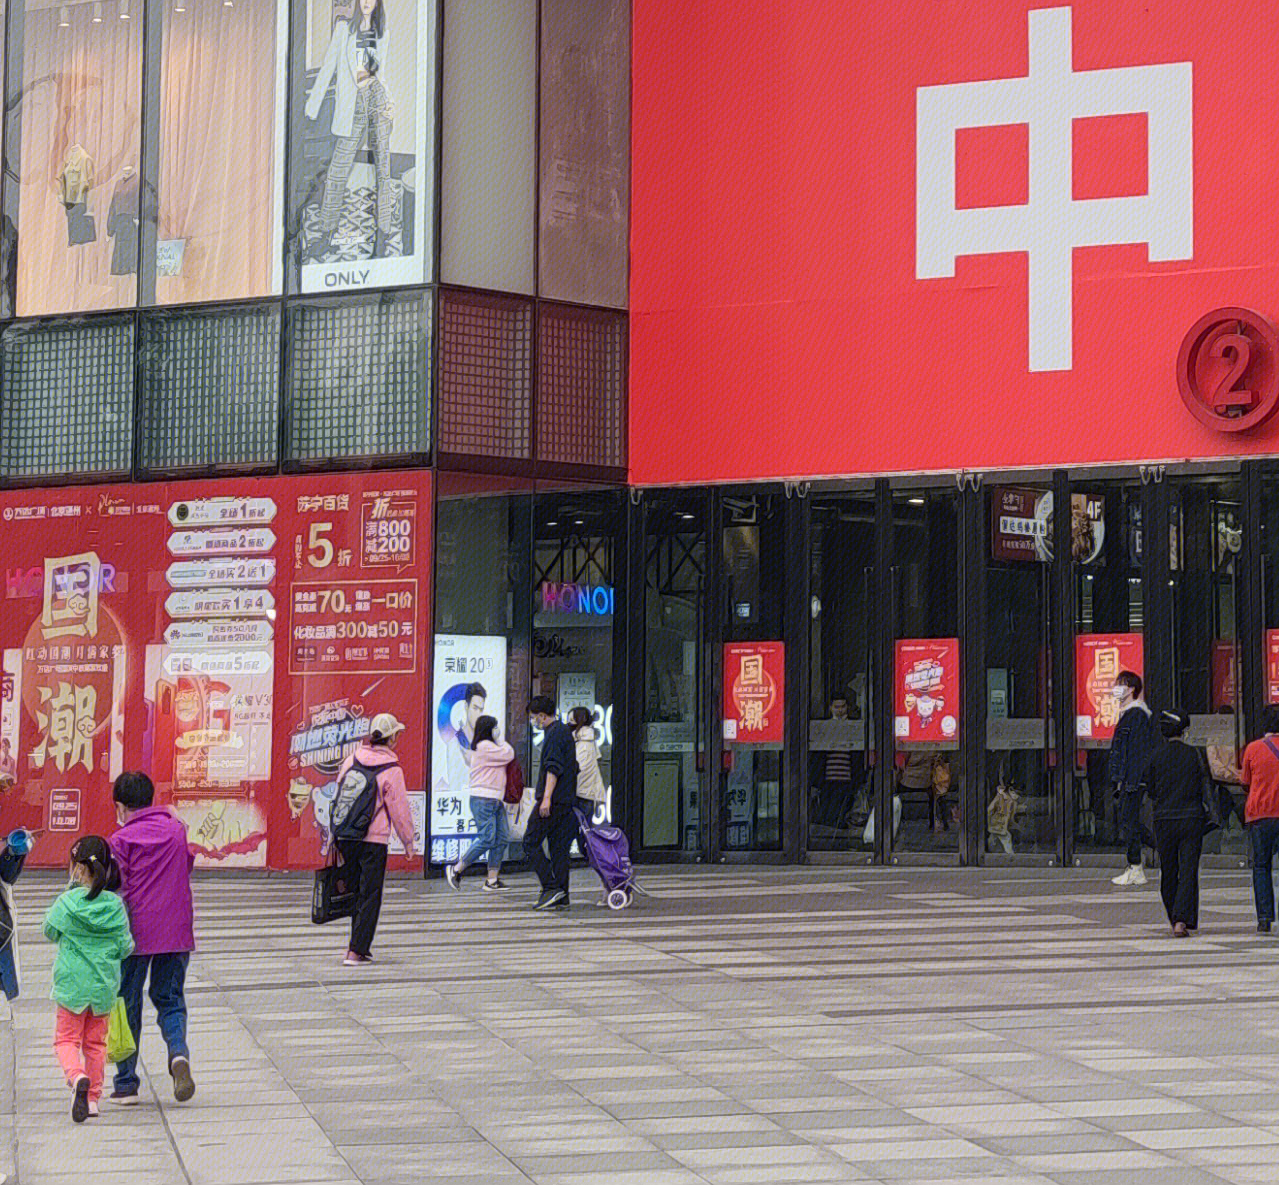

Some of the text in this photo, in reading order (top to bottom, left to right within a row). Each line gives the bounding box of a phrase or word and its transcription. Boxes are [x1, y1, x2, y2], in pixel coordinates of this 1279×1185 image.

[324, 270, 370, 287] ONLY
[40, 551, 101, 640] 国
[740, 654, 764, 685] 国
[1094, 647, 1119, 681] 国
[33, 681, 98, 775] 潮
